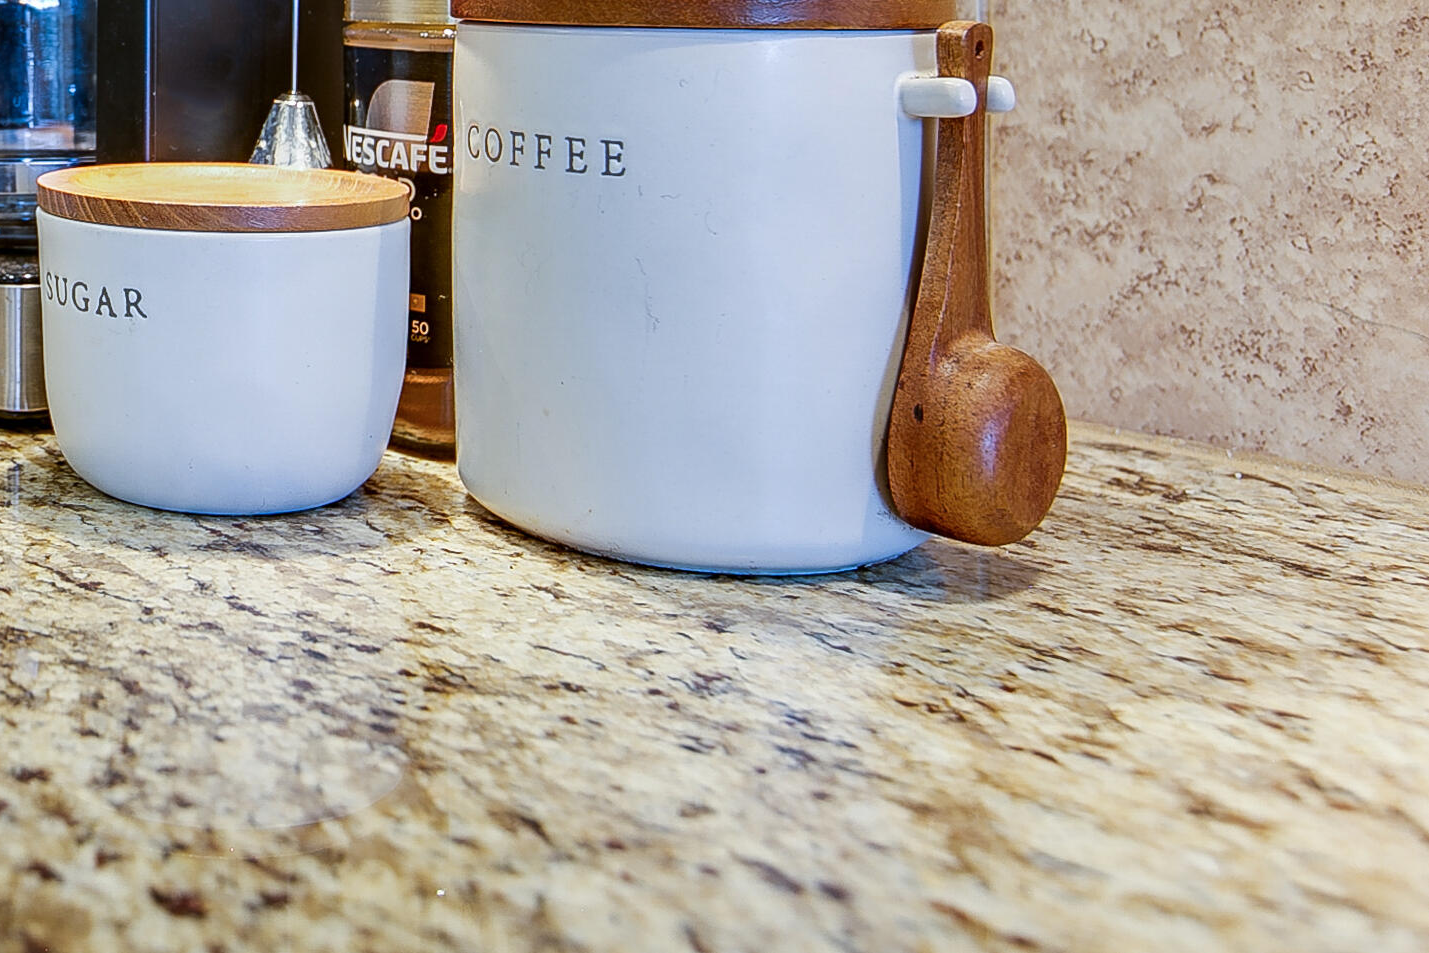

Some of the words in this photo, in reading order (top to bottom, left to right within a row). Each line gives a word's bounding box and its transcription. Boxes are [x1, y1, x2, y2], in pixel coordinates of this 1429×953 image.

[467, 124, 627, 178] COFFEE
[45, 271, 148, 319] SUGAR
[411, 319, 429, 336] 50
